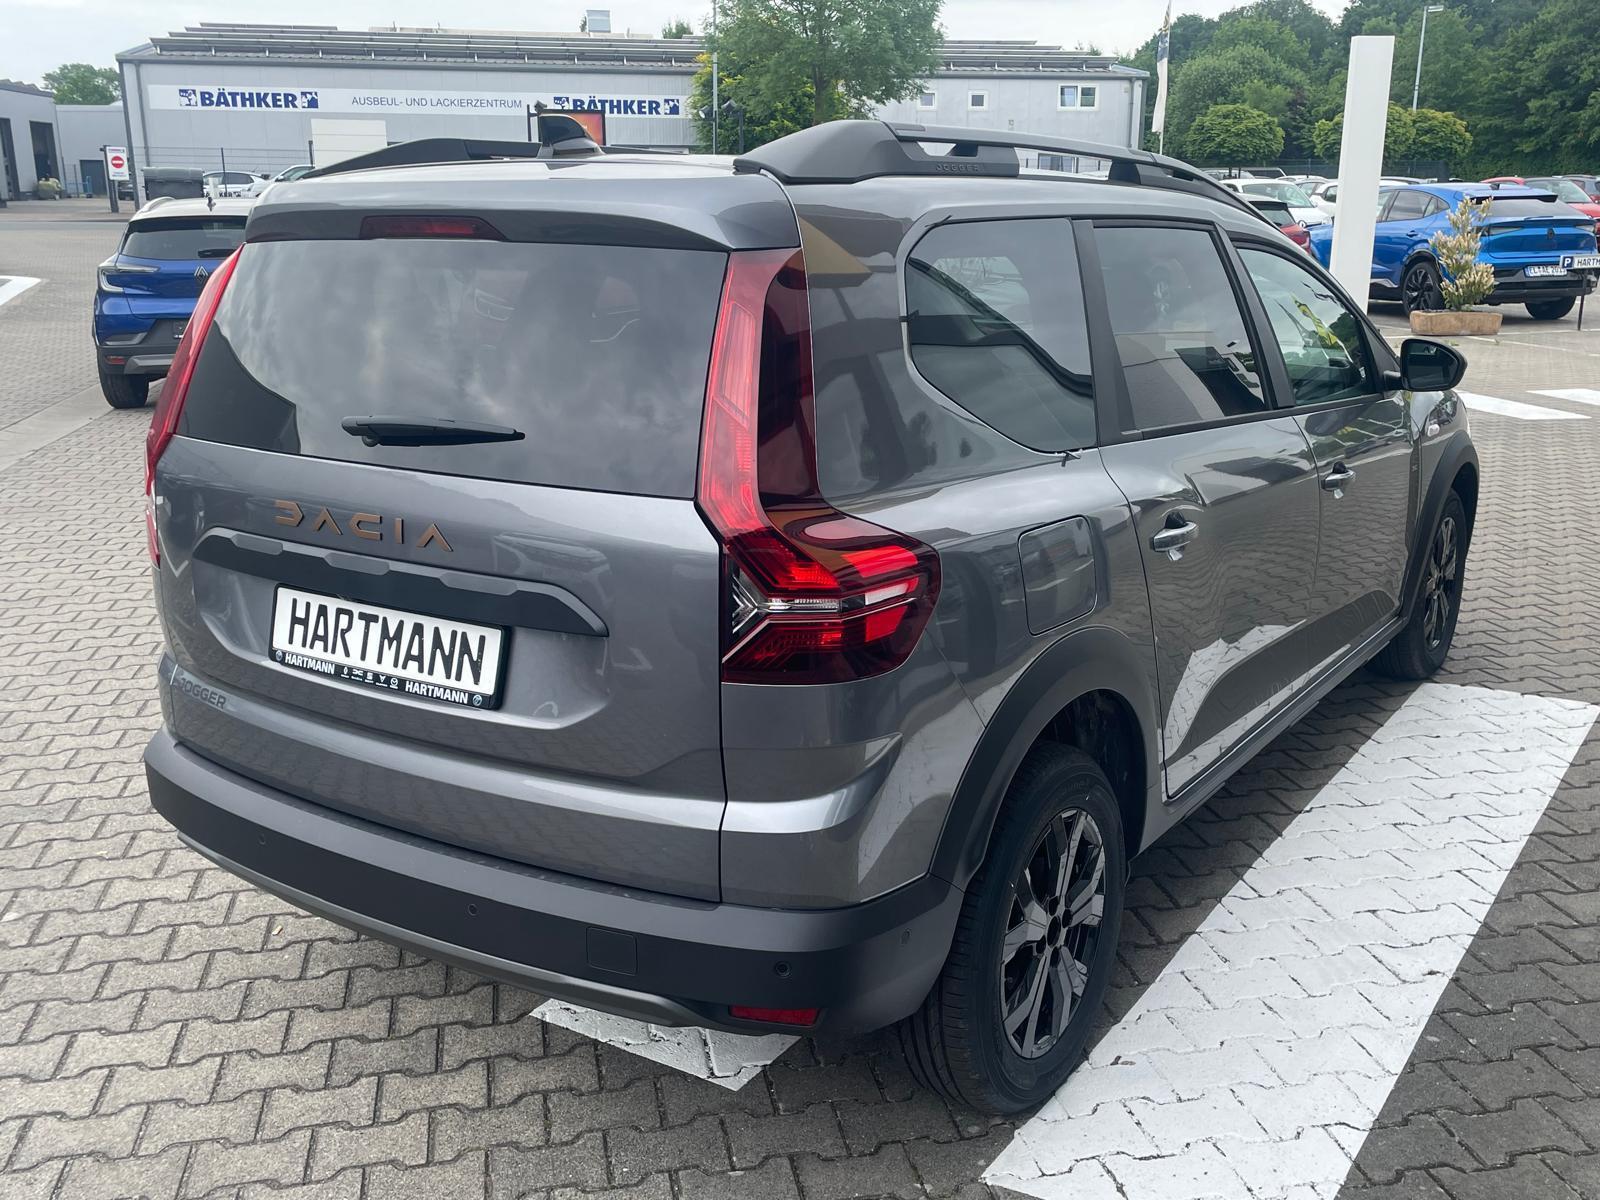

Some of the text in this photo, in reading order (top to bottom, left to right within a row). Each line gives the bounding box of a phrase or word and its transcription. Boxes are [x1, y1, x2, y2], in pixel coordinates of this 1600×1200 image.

[200, 88, 298, 109] BÄTHKER
[351, 96, 522, 108] AUSBEUL- UND LACKIERZENTRUM
[572, 95, 661, 115] BÄTHKER
[273, 499, 455, 552] DACIA
[287, 597, 487, 686] HARTMANN
[284, 652, 336, 675] HARTMANN
[405, 680, 469, 705] HARTMANN
